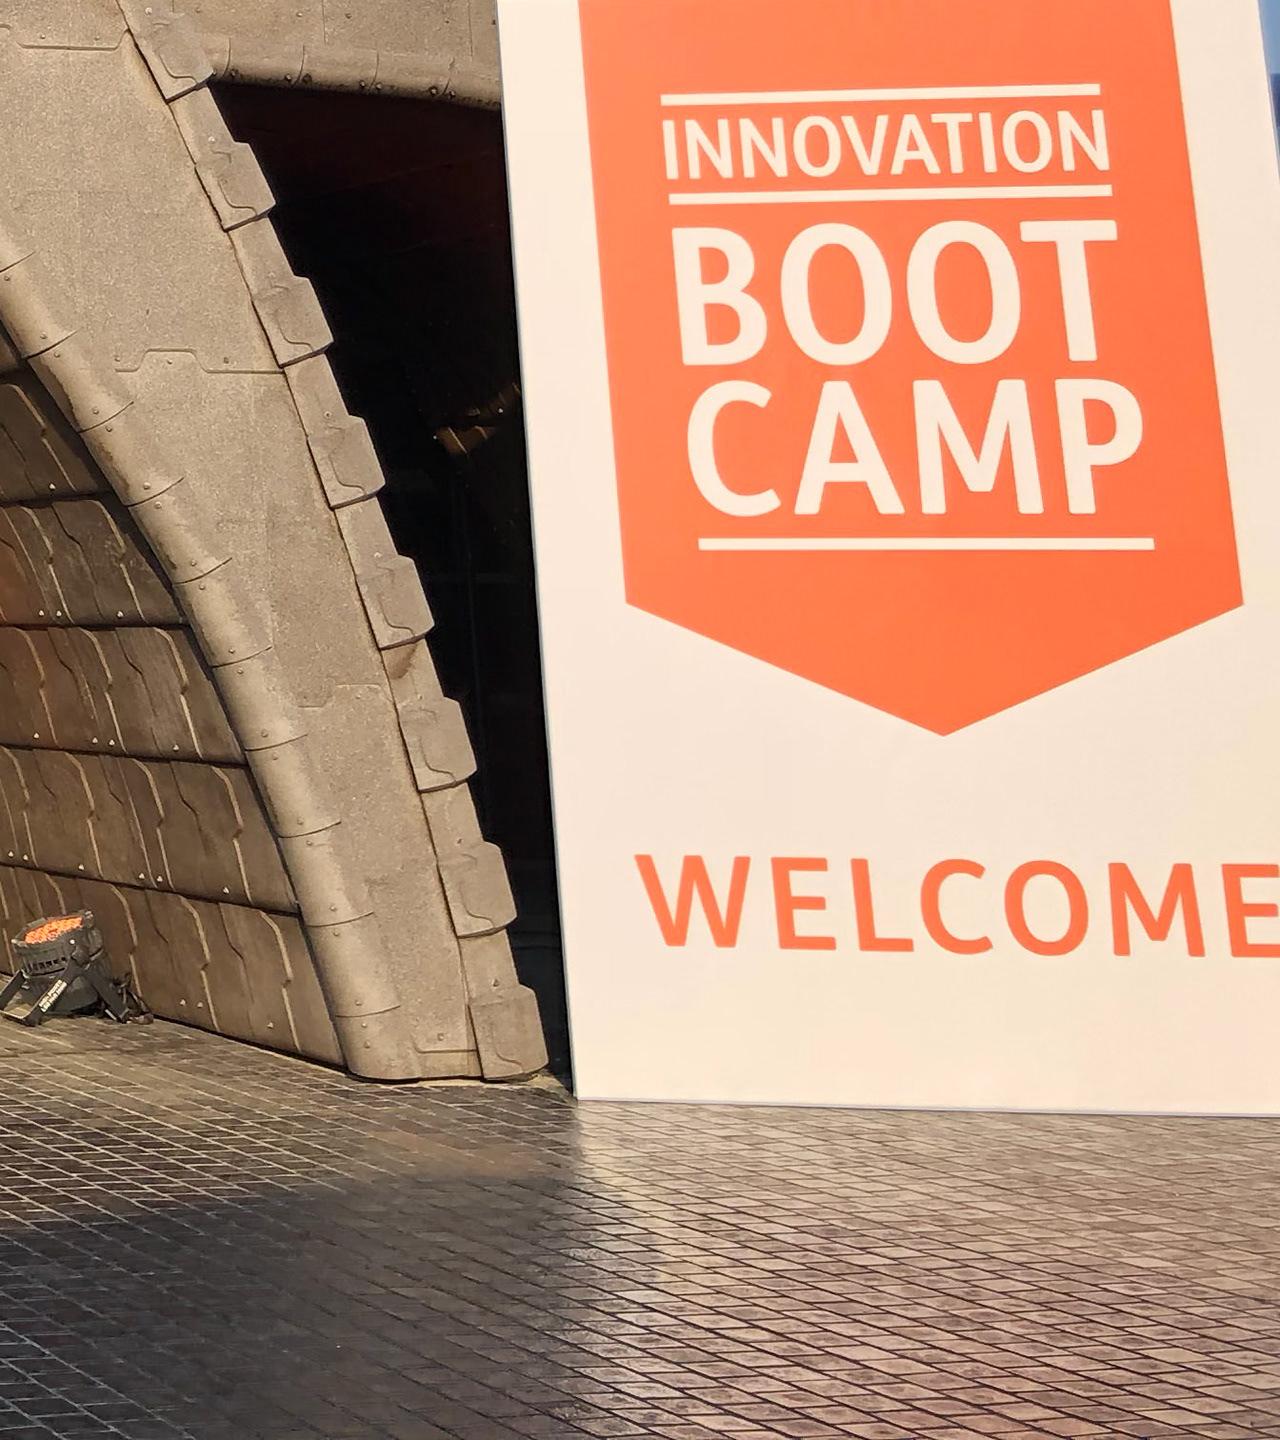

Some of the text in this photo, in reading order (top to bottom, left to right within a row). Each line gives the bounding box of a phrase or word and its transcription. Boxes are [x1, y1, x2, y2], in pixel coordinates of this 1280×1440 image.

[663, 110, 1109, 180] INNOVATION
[672, 220, 1117, 365] BOOT
[688, 379, 1142, 516] CAMP
[635, 855, 1280, 958] WELCOME
